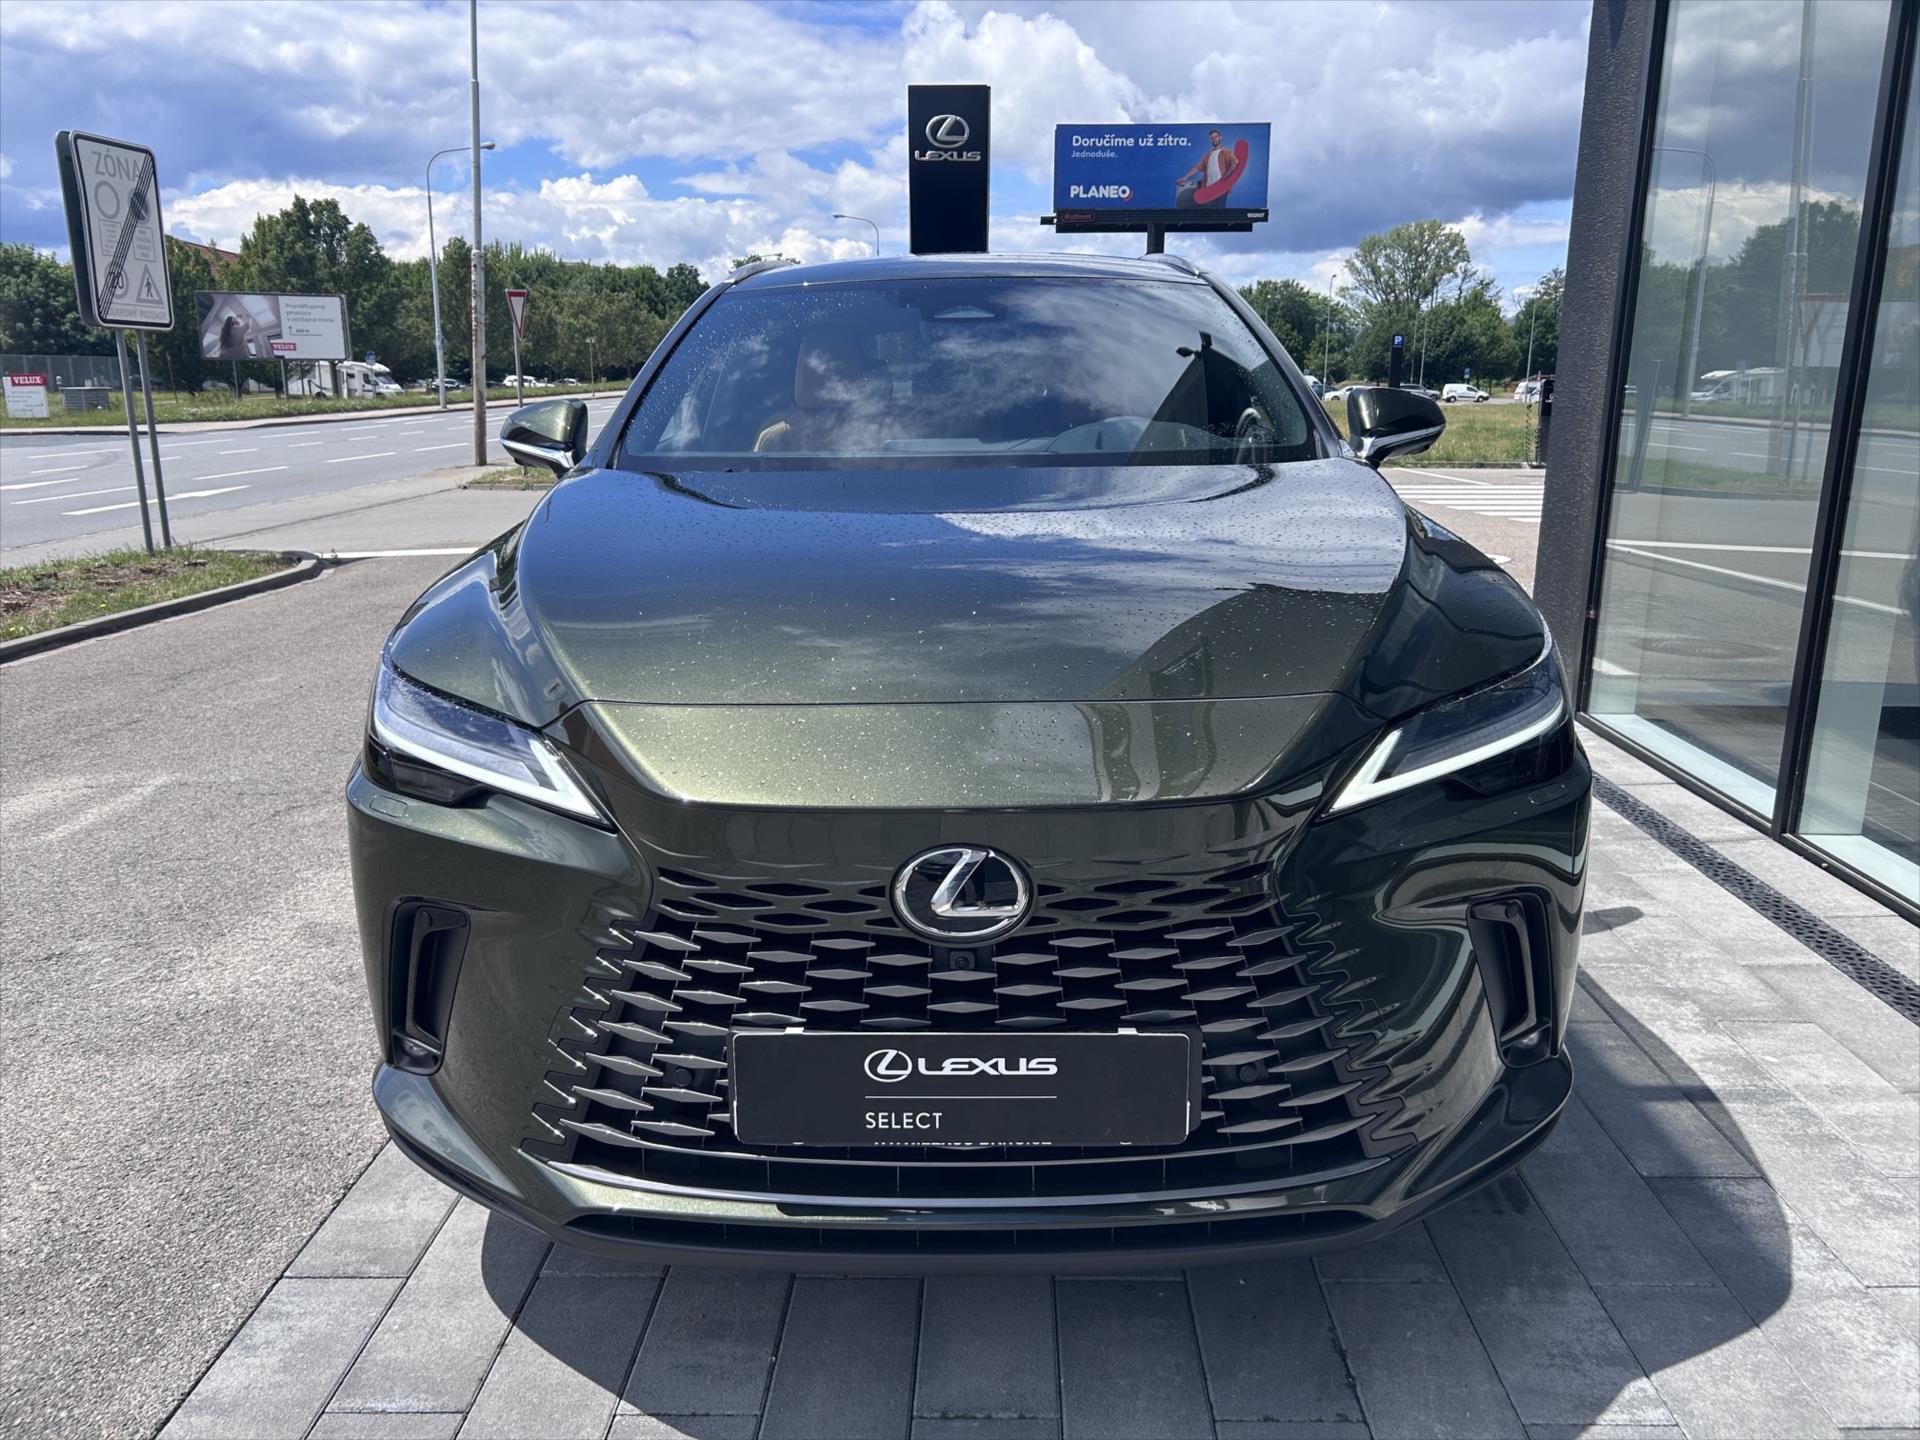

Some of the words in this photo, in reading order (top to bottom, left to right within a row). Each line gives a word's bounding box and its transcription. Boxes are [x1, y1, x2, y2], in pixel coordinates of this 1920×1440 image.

[1072, 134, 1134, 147] Doručíme
[1139, 134, 1154, 147] už
[1157, 133, 1191, 147] zítra.
[914, 150, 982, 161] LEXUS
[1071, 150, 1118, 158] Jednoduše.
[92, 148, 142, 182] ZÓNA
[1070, 185, 1130, 198] PLANEO
[1394, 335, 1402, 344] P
[917, 1057, 1058, 1075] LEXUS
[865, 1112, 943, 1129] SELECT
